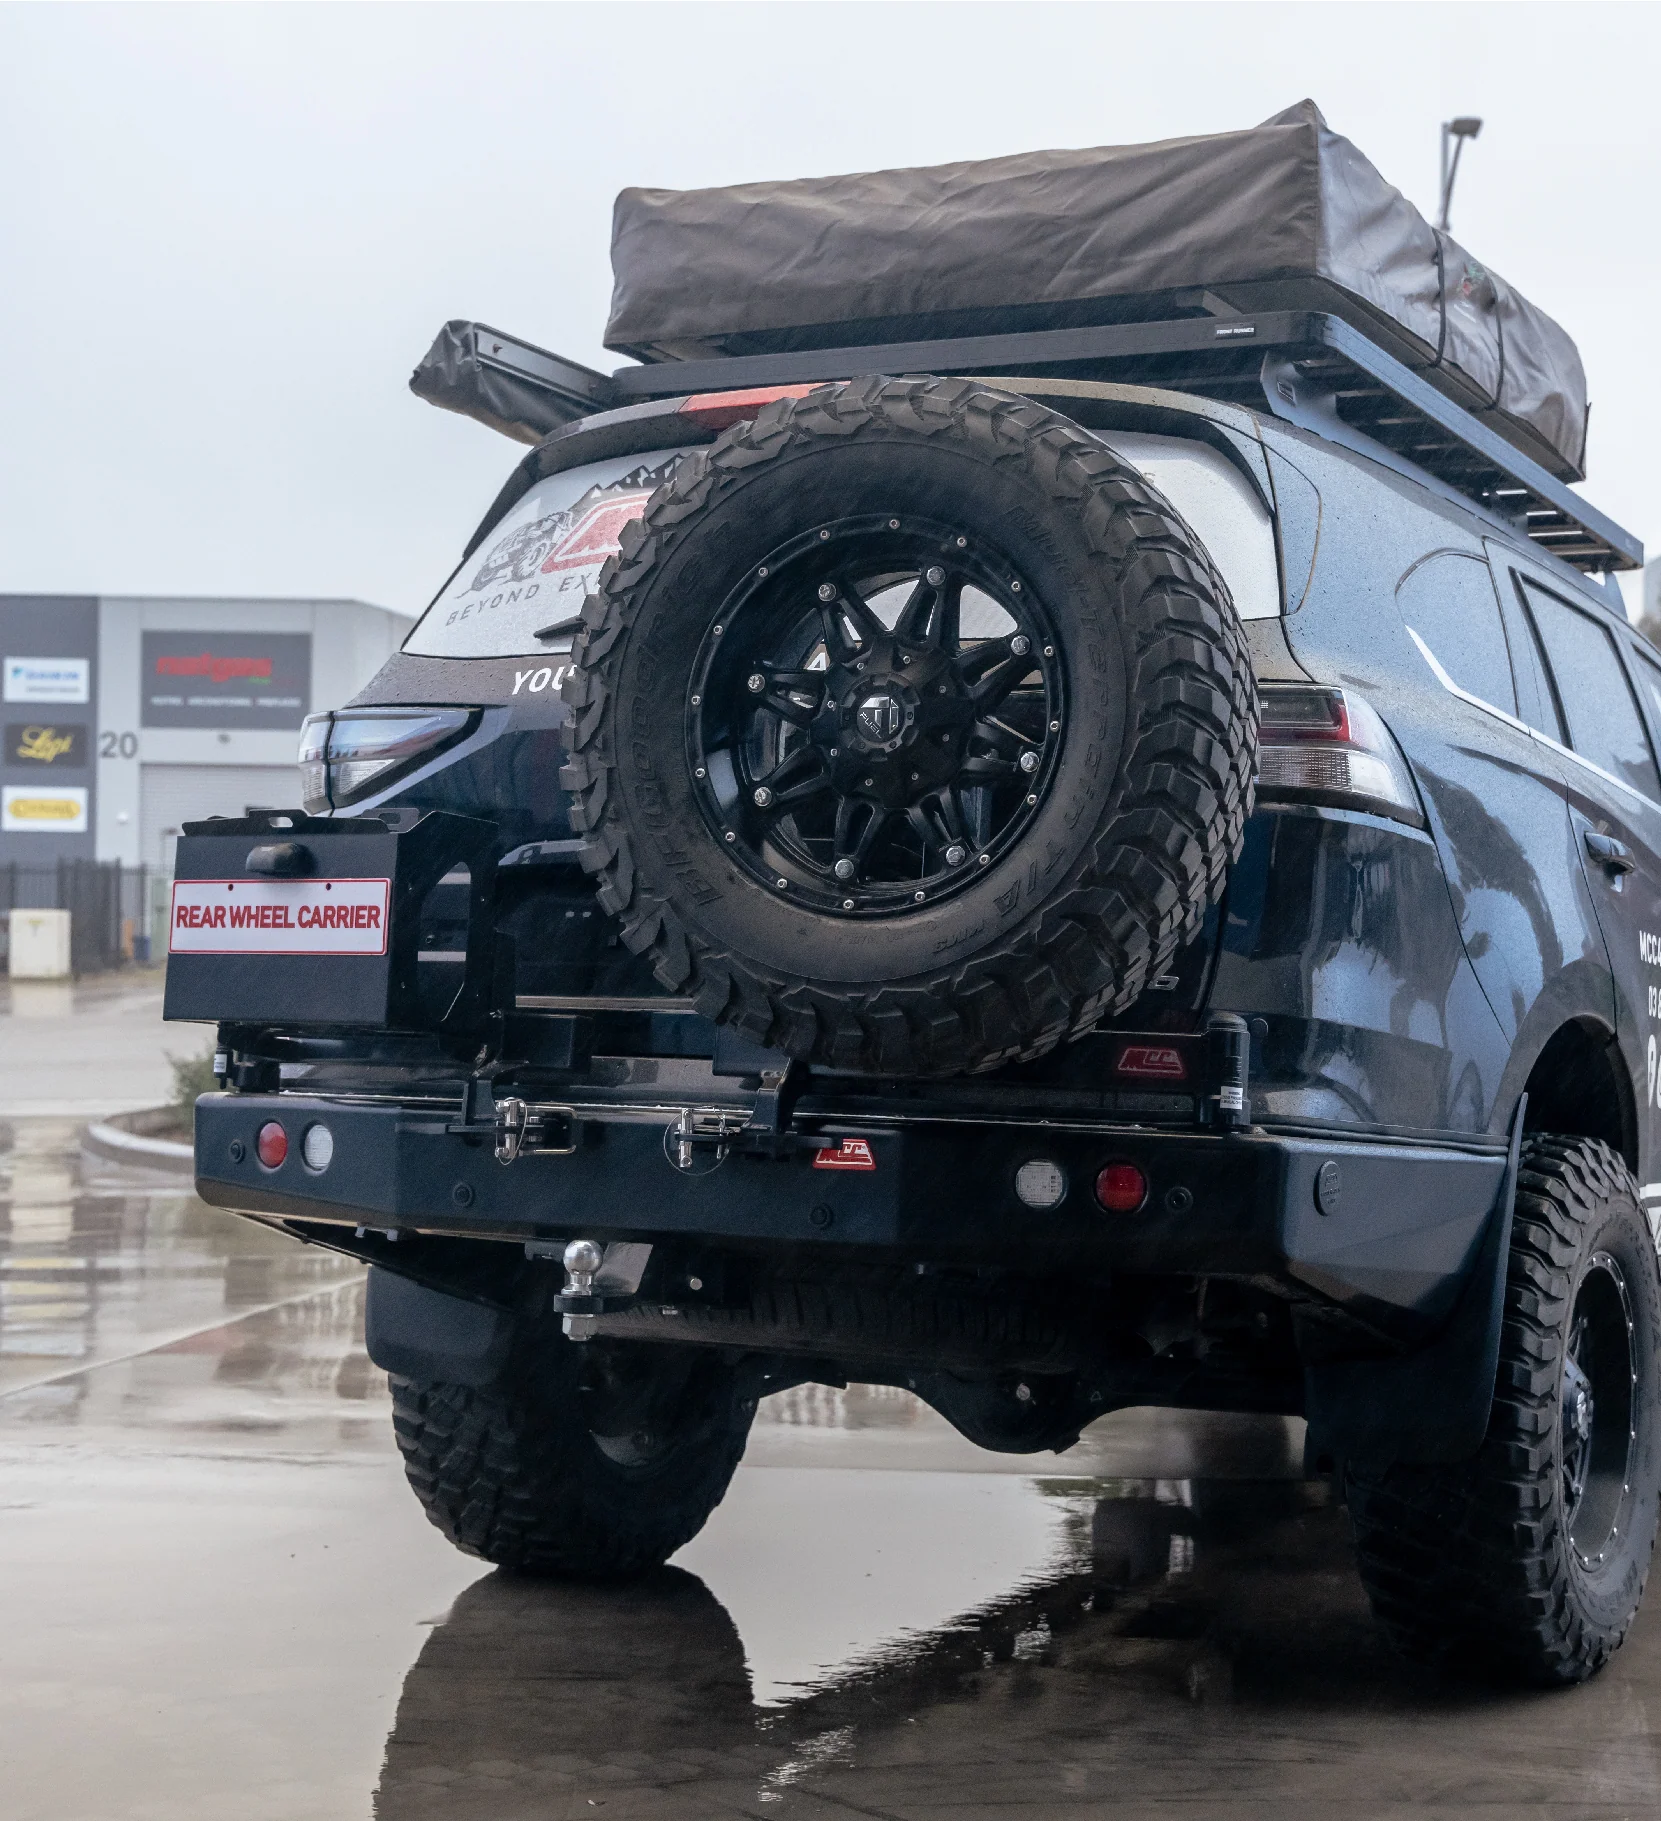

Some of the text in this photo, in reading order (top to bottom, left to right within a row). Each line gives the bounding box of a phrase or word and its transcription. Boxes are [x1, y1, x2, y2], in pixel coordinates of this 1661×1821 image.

[446, 572, 601, 627] BEYOND EX
[859, 711, 882, 739] FUEL
[100, 731, 138, 759] 20
[176, 905, 381, 929] REAR WHEEL CARRIER
